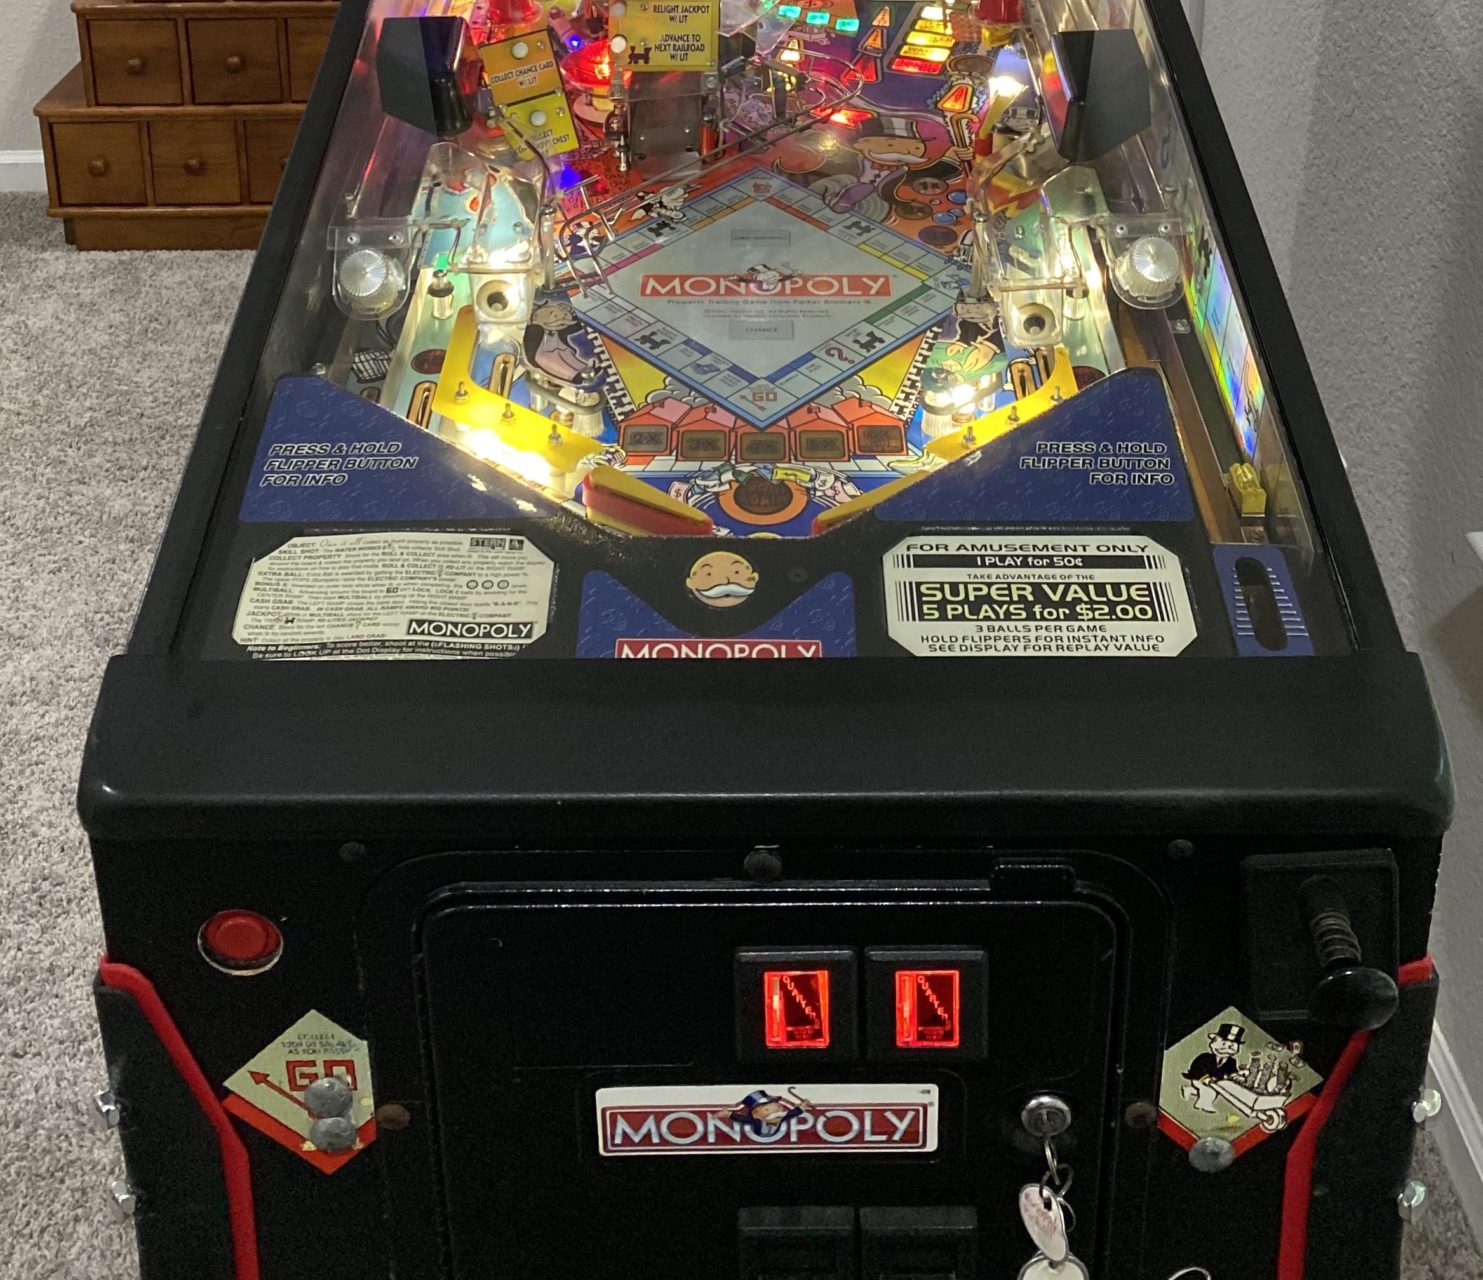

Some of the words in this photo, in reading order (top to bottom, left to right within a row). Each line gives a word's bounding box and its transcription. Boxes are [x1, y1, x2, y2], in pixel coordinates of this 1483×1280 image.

[653, 5, 679, 14] RELIGHT
[681, 5, 710, 15] JACKPOT
[661, 34, 690, 43] ADVANCE
[692, 34, 701, 42] TO
[654, 44, 671, 52] NEXT
[673, 44, 705, 52] RAILROAD
[490, 72, 515, 84] COLLECT
[515, 66, 539, 78] CHANCE
[539, 61, 555, 71] CARD
[552, 134, 570, 145] CHEST
[645, 276, 886, 296] MONOPOLY
[753, 392, 777, 401] GO
[269, 443, 331, 456] PRESS
[332, 443, 347, 455] &
[350, 442, 401, 455] HOLD
[1036, 442, 1096, 454] PRESS
[1099, 442, 1113, 454] &
[1116, 442, 1167, 454] HOLD
[264, 458, 341, 471] FLIPPER
[343, 456, 418, 470] BUTTON
[1020, 456, 1094, 469] FLIPPER
[1097, 457, 1170, 470] BUTTON
[259, 474, 302, 487] FOR
[302, 473, 348, 486] INFO
[1089, 472, 1128, 485] FOR
[1131, 472, 1175, 486] INFO
[906, 544, 950, 553] FOR
[955, 544, 1091, 553] AMUSEMENT
[1096, 544, 1149, 553] ONLY
[985, 556, 1023, 567] PLAY
[1027, 556, 1050, 567] for
[1053, 556, 1084, 567] 50¢
[920, 583, 1033, 602] SUPER
[1041, 583, 1151, 602] VALUE
[923, 605, 939, 619] 5
[946, 605, 1027, 620] PLAYS
[1033, 605, 1070, 620] for
[1076, 604, 1152, 621] $2.00
[409, 622, 532, 638] MONOPOLY
[975, 625, 983, 633] 3
[987, 625, 1032, 633] BALLS
[1035, 625, 1064, 633] PER
[1066, 625, 1107, 633] GAME
[921, 635, 964, 644] HOLD
[965, 635, 1032, 644] FLIPPERS
[1034, 635, 1064, 643] FOR
[1066, 635, 1127, 643] INSTANT
[1130, 635, 1165, 643] INFO
[621, 643, 816, 659] MONOPOLY
[929, 644, 958, 652] SEE
[960, 644, 1020, 652] DISPLAY
[1023, 644, 1053, 652] FOR
[1056, 644, 1109, 652] REPLAY
[1111, 643, 1160, 652] VALUE
[614, 1110, 916, 1144] MONOPOLY
